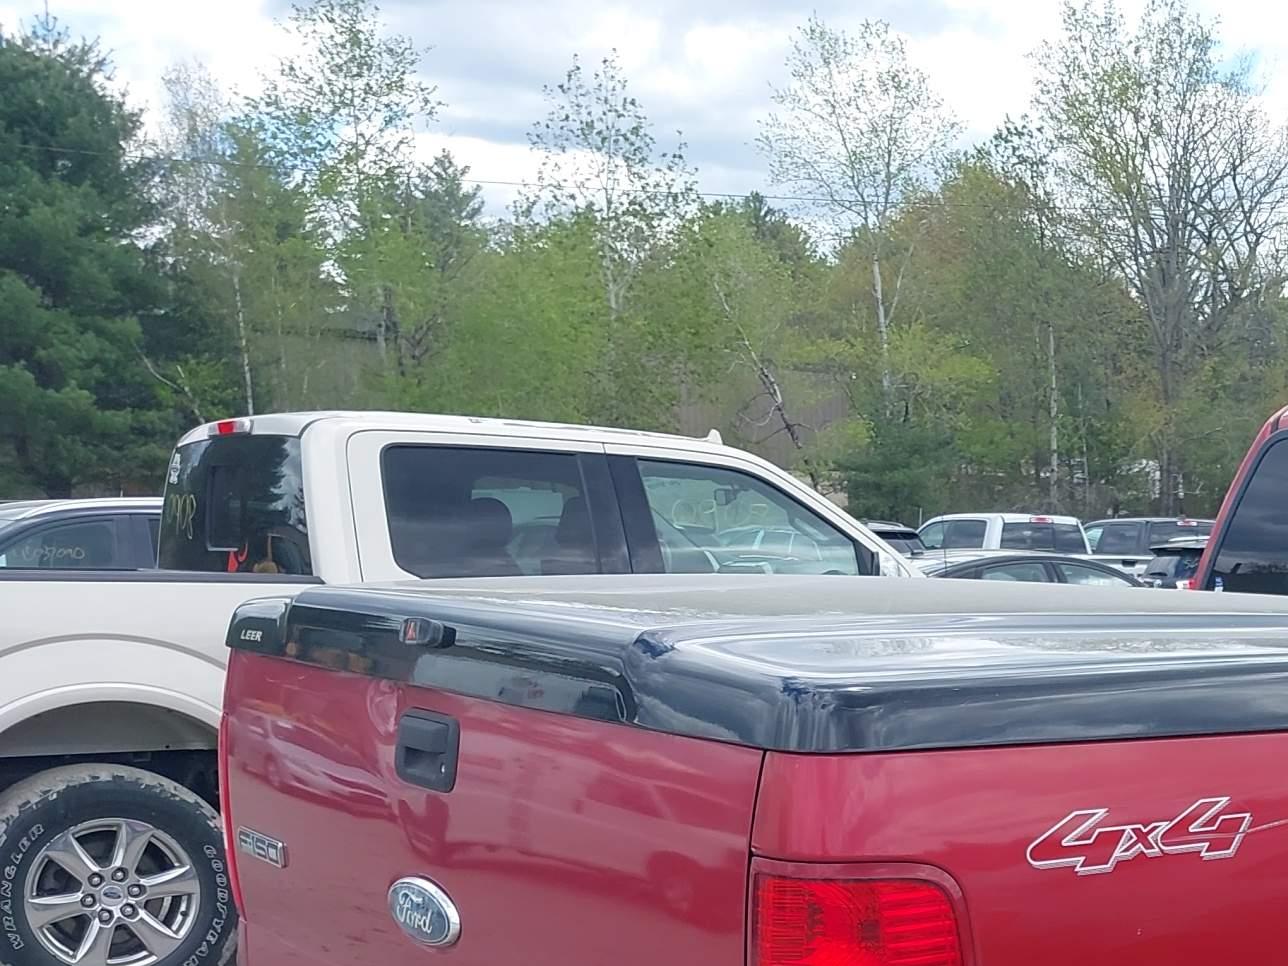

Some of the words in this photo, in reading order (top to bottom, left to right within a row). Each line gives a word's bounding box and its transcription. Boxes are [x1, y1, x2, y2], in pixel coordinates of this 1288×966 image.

[240, 629, 263, 642] LEER
[1026, 797, 1252, 875] 4x4
[1, 824, 44, 950] WRANGLER
[396, 890, 433, 934] Ford
